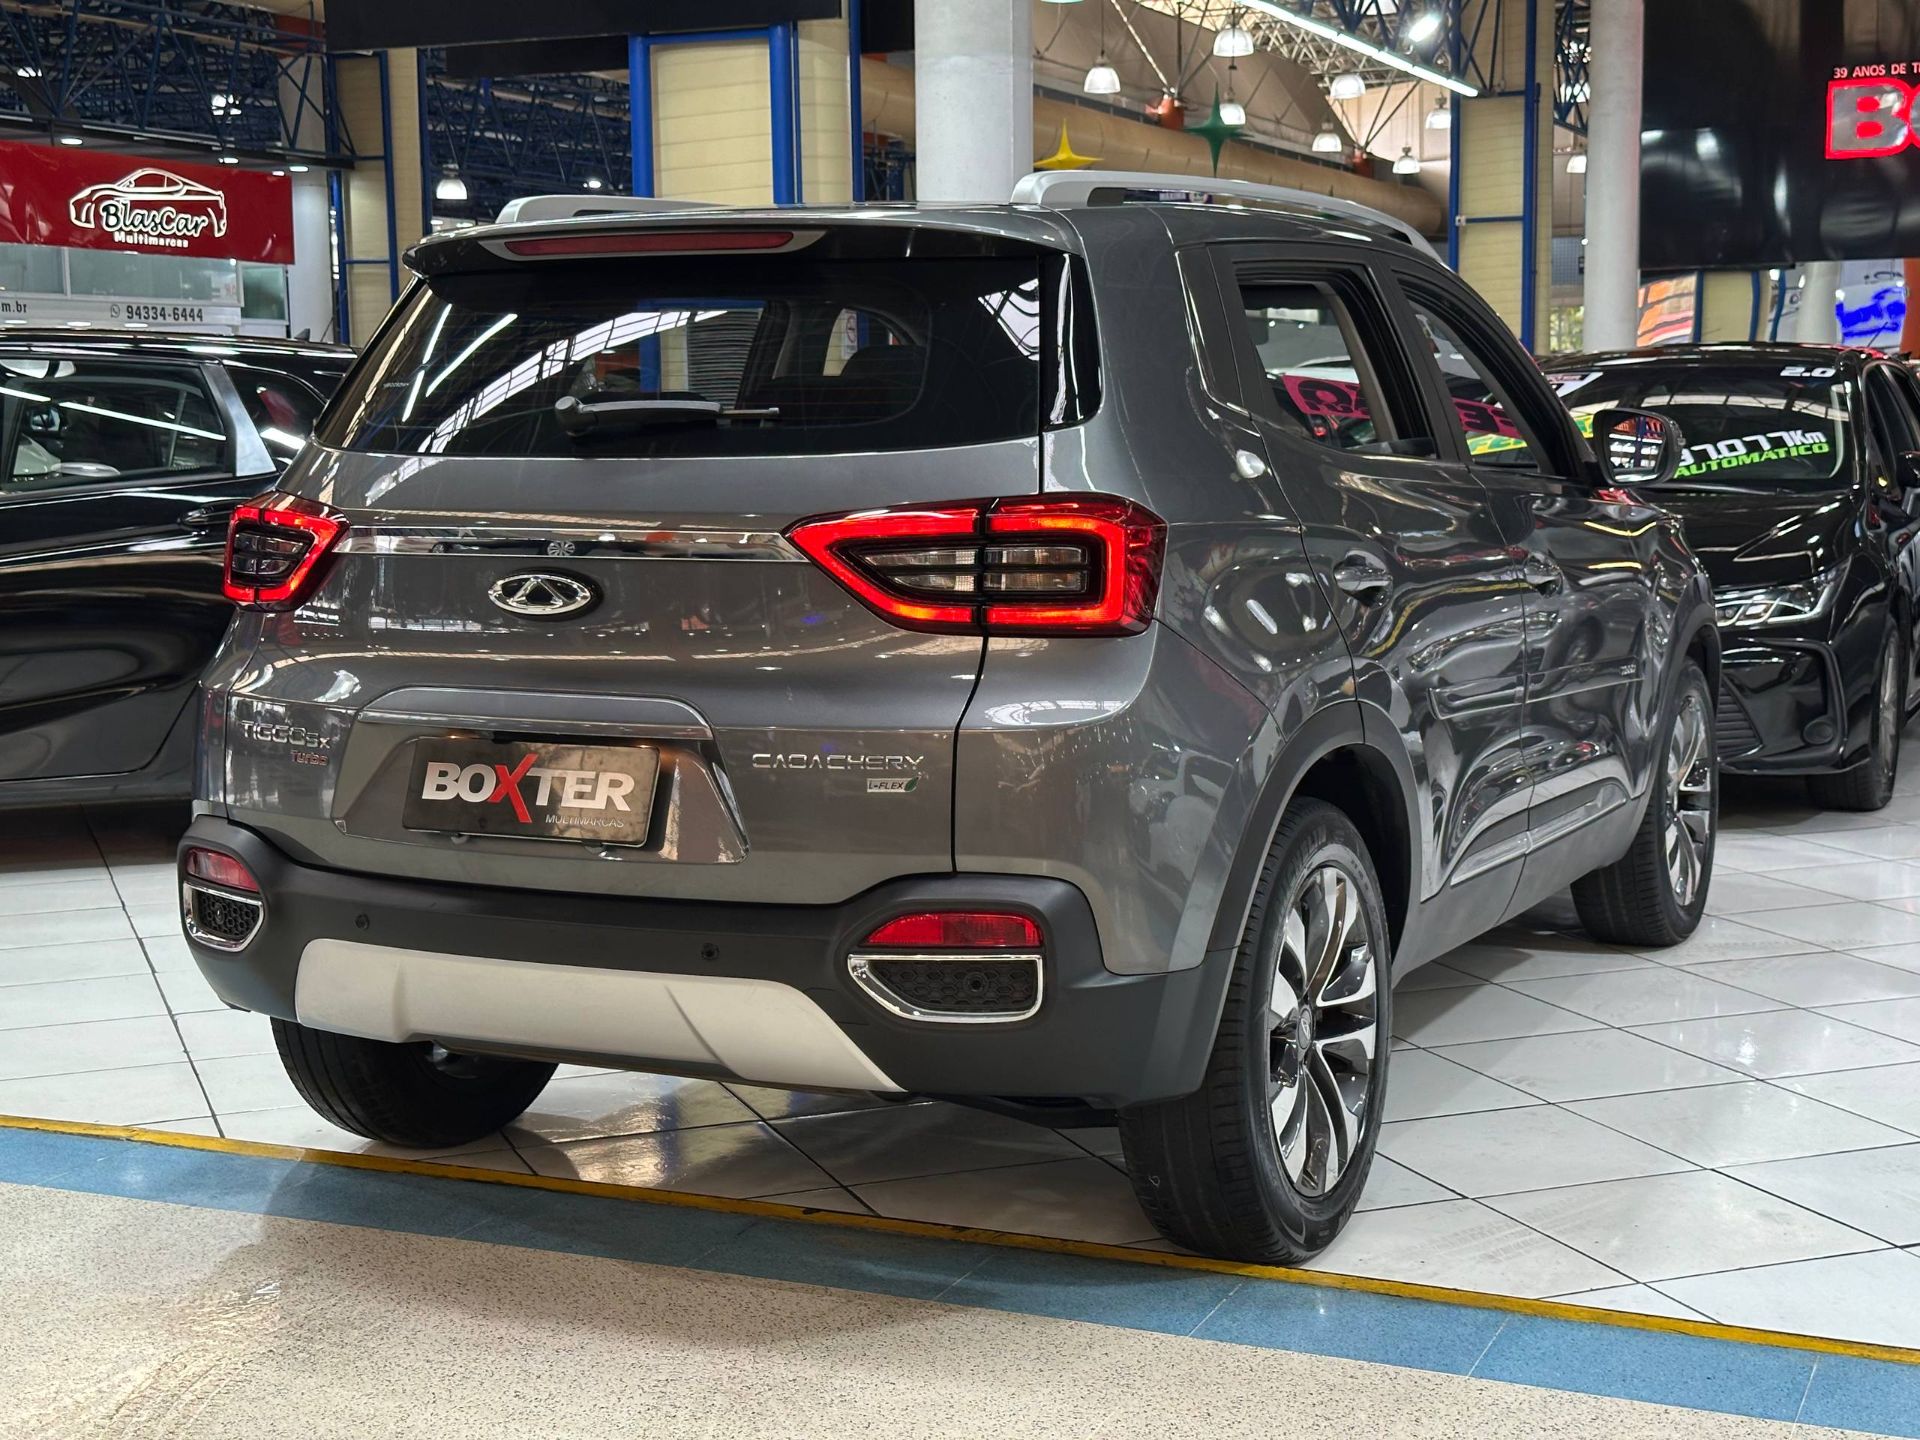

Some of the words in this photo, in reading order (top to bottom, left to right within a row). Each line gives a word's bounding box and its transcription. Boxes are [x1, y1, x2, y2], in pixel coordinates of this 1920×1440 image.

[1833, 67, 1848, 79] 39
[1853, 64, 1886, 78] ANOS
[1891, 63, 1907, 75] DE
[1912, 62, 1920, 74] T
[1825, 77, 1920, 159] B
[101, 200, 208, 237] BlasCar
[126, 304, 204, 322] 94334-6444
[1780, 366, 1837, 378] 2.0
[1673, 442, 1829, 479] AUTOMATICO
[421, 753, 635, 824] BOXTER
